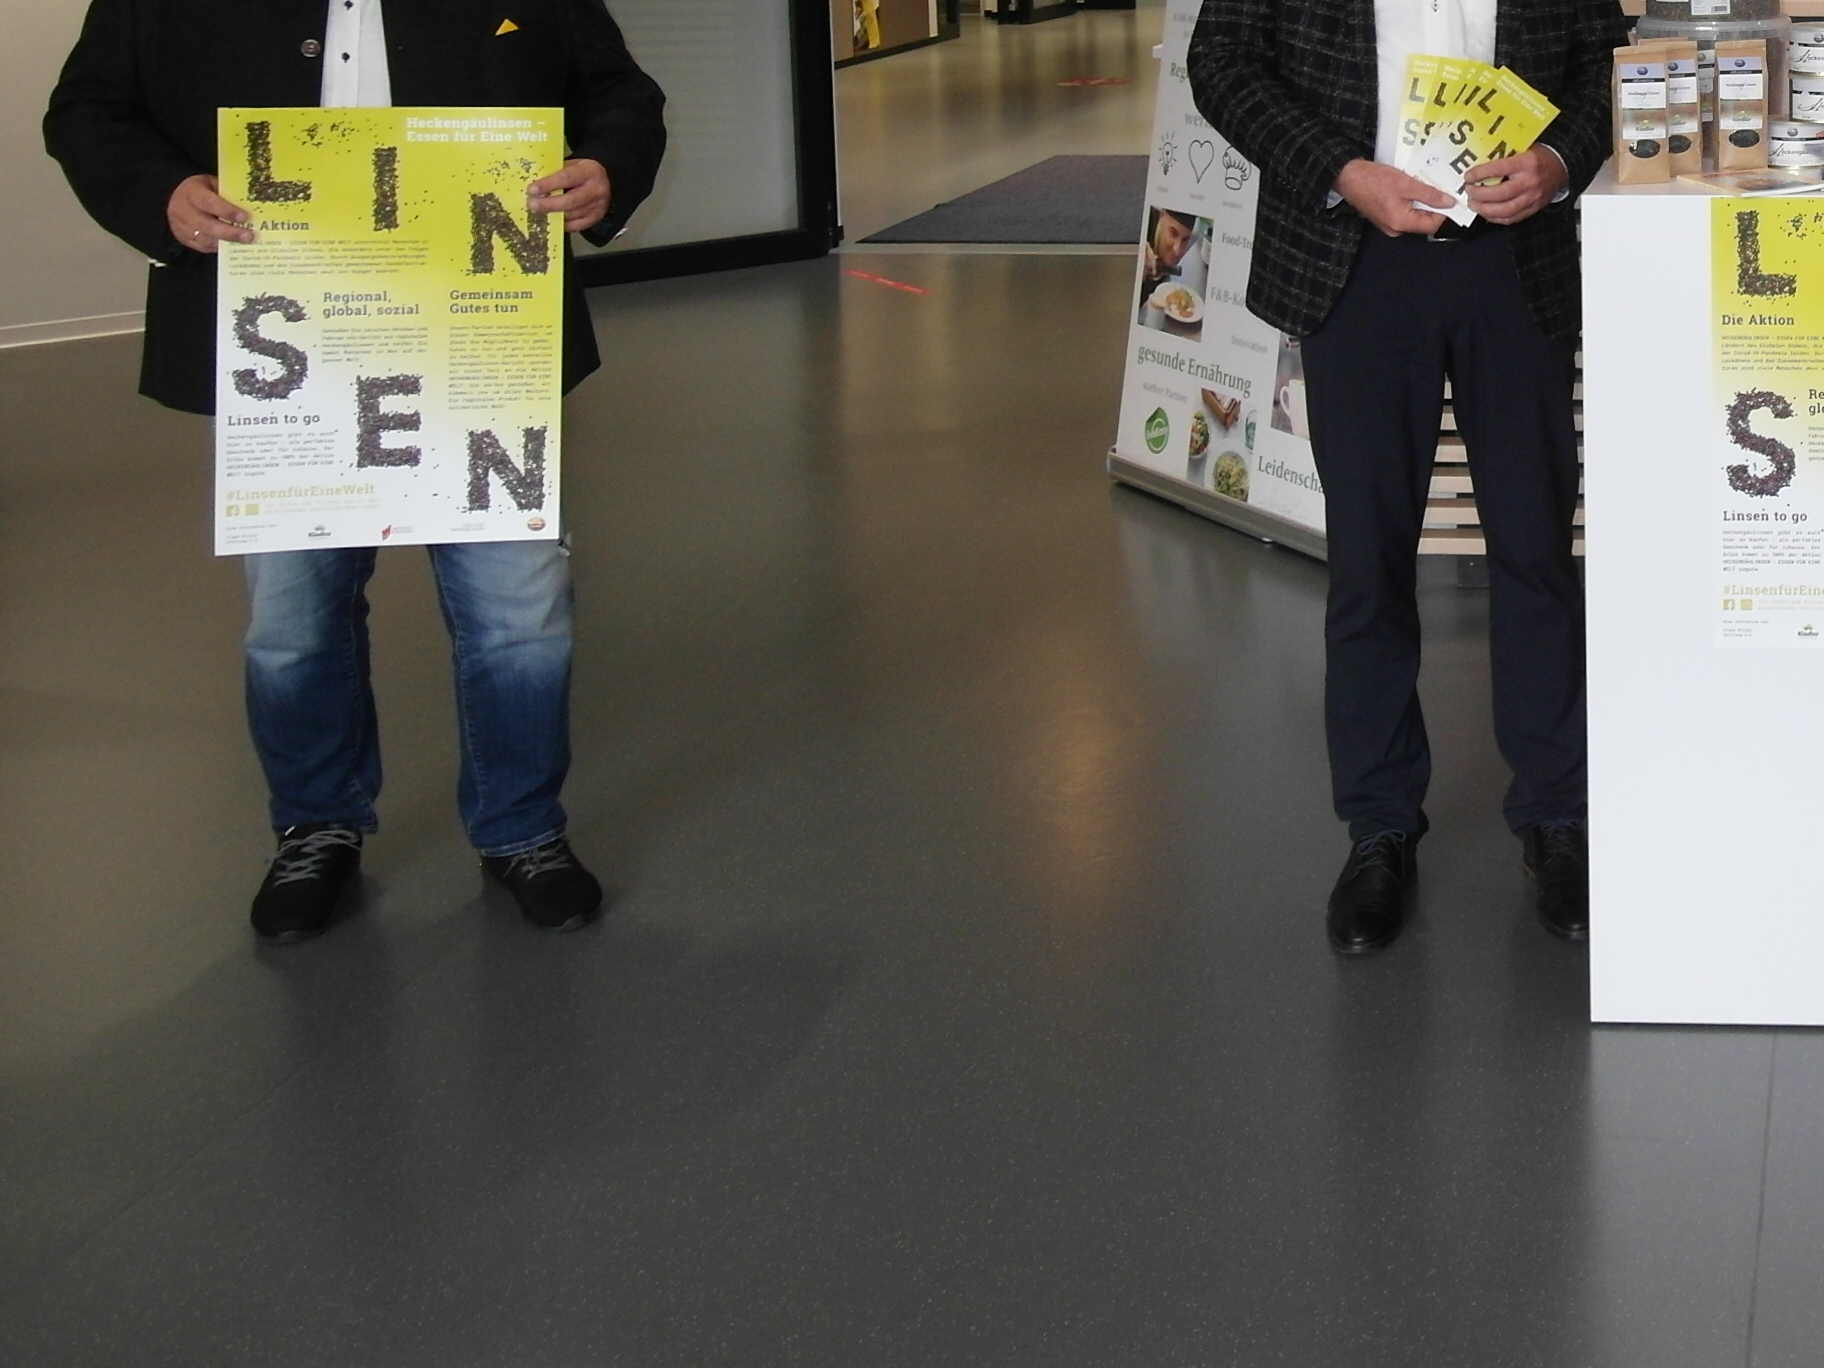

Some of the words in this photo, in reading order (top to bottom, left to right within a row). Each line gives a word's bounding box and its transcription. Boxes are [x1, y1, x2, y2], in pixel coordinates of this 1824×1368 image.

[406, 116, 532, 131] Heckengäulinsen
[406, 131, 449, 143] Essen
[454, 130, 476, 143] für
[480, 131, 513, 143] Eine
[517, 130, 548, 143] Welt
[259, 219, 310, 231] Aktion
[322, 290, 392, 304] Regional,
[449, 288, 534, 300] Gemeinsam
[322, 305, 372, 319] global,
[376, 303, 420, 316] sozial
[449, 302, 490, 314] Gutes
[494, 303, 519, 314] tun
[1721, 313, 1744, 326] Die
[1748, 313, 1795, 326] Aktion
[1136, 345, 1186, 373] gesunde
[1187, 357, 1252, 399] Ernährung
[227, 414, 279, 427] Linsen
[283, 413, 298, 425] to
[302, 414, 321, 426] go
[226, 482, 376, 501] #LinsenfürEineWelt
[1722, 510, 1770, 522] Linsen
[1774, 511, 1787, 522] to
[1791, 512, 1808, 524] go
